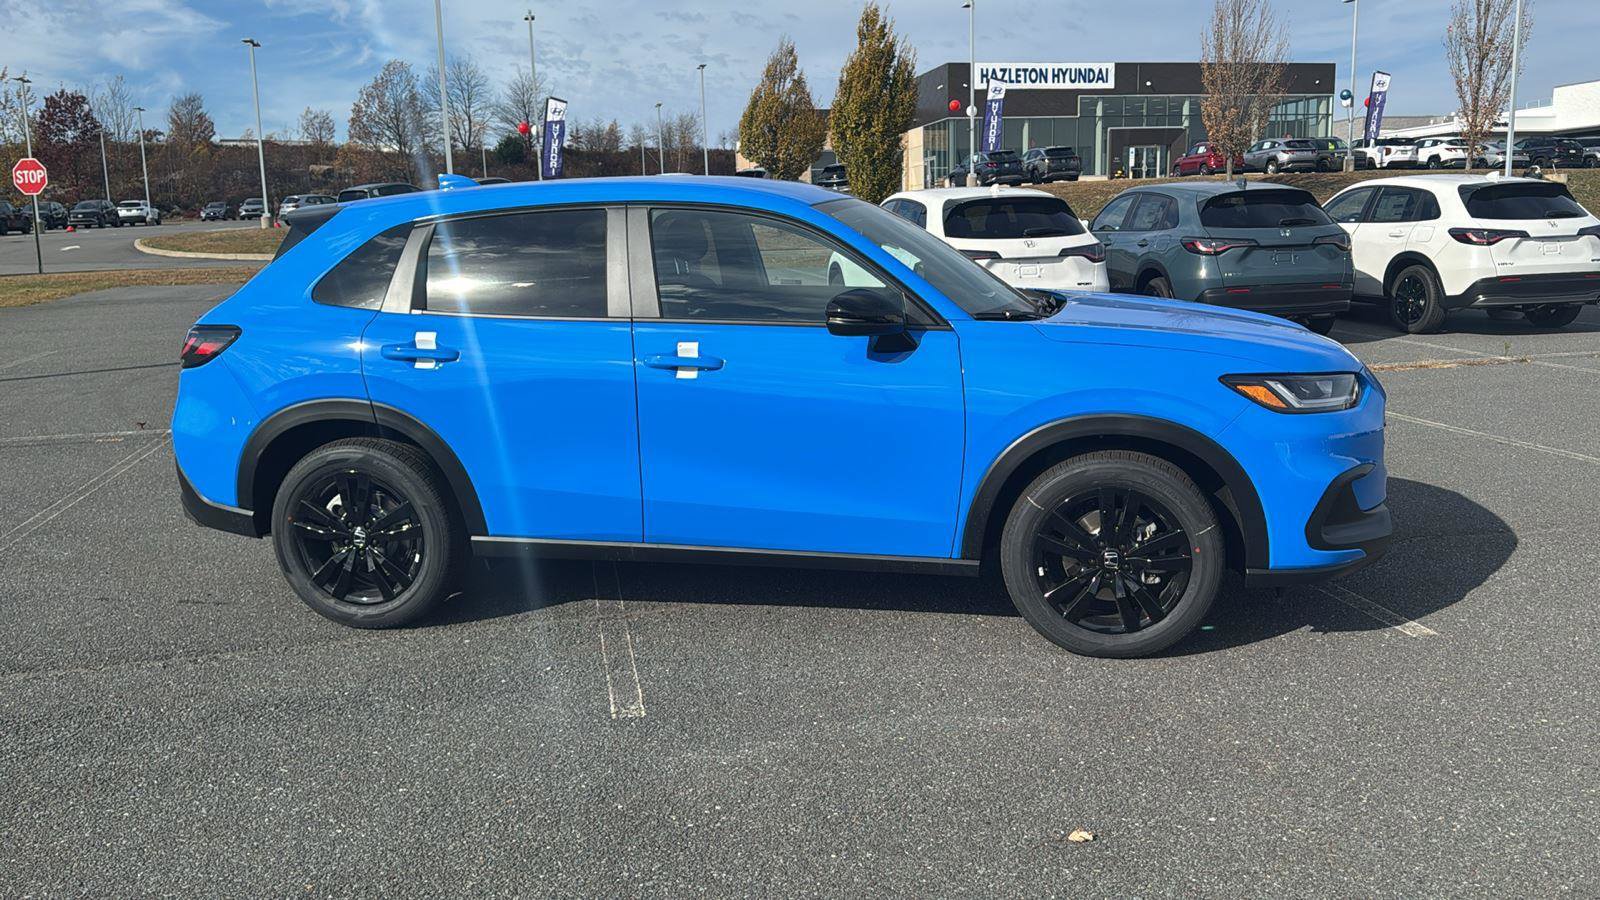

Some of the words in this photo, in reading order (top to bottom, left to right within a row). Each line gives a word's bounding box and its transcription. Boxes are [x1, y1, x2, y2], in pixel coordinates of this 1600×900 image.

[980, 67, 1048, 84] HAZLETON
[1052, 67, 1109, 84] HYUNDAI
[988, 101, 999, 151] HYUNDAI
[549, 123, 560, 176] HYUNDAI
[16, 169, 45, 184] STOP
